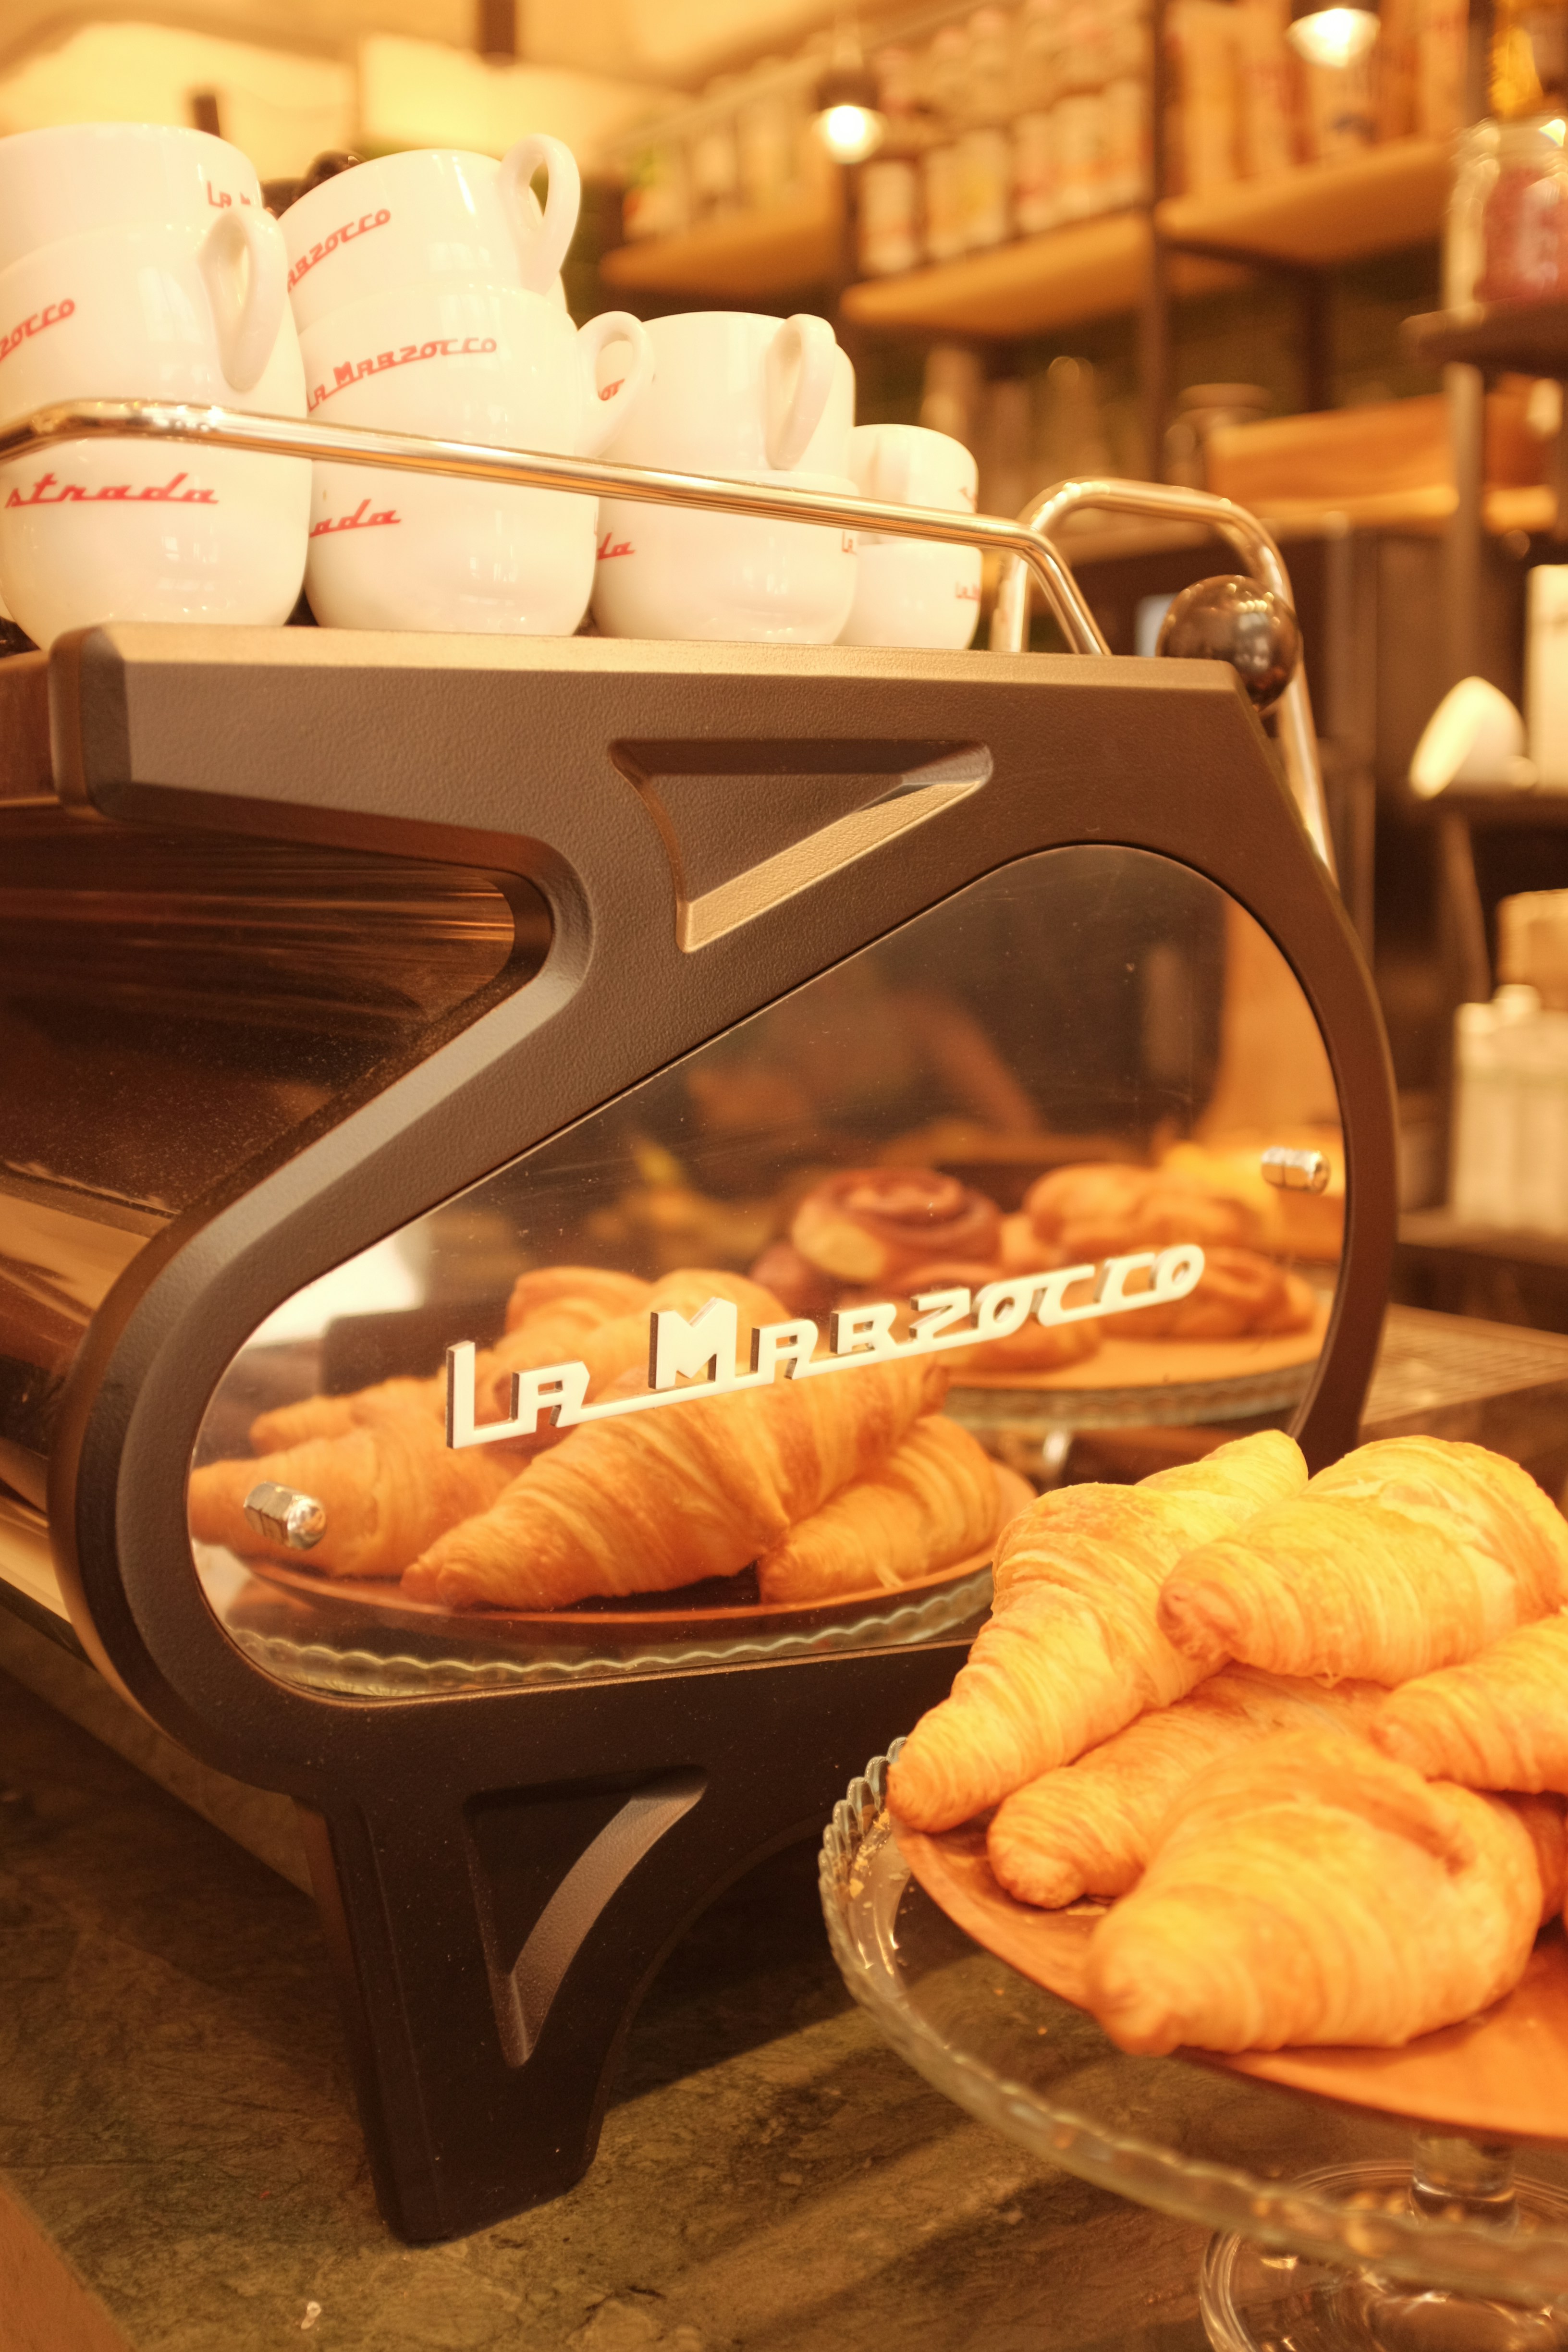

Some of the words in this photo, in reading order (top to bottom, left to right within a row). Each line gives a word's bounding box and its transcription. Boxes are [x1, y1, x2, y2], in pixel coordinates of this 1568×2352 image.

[5, 472, 219, 508] strada
[446, 1340, 591, 1449] LA
[649, 1243, 1205, 1409] MARZOCCO
